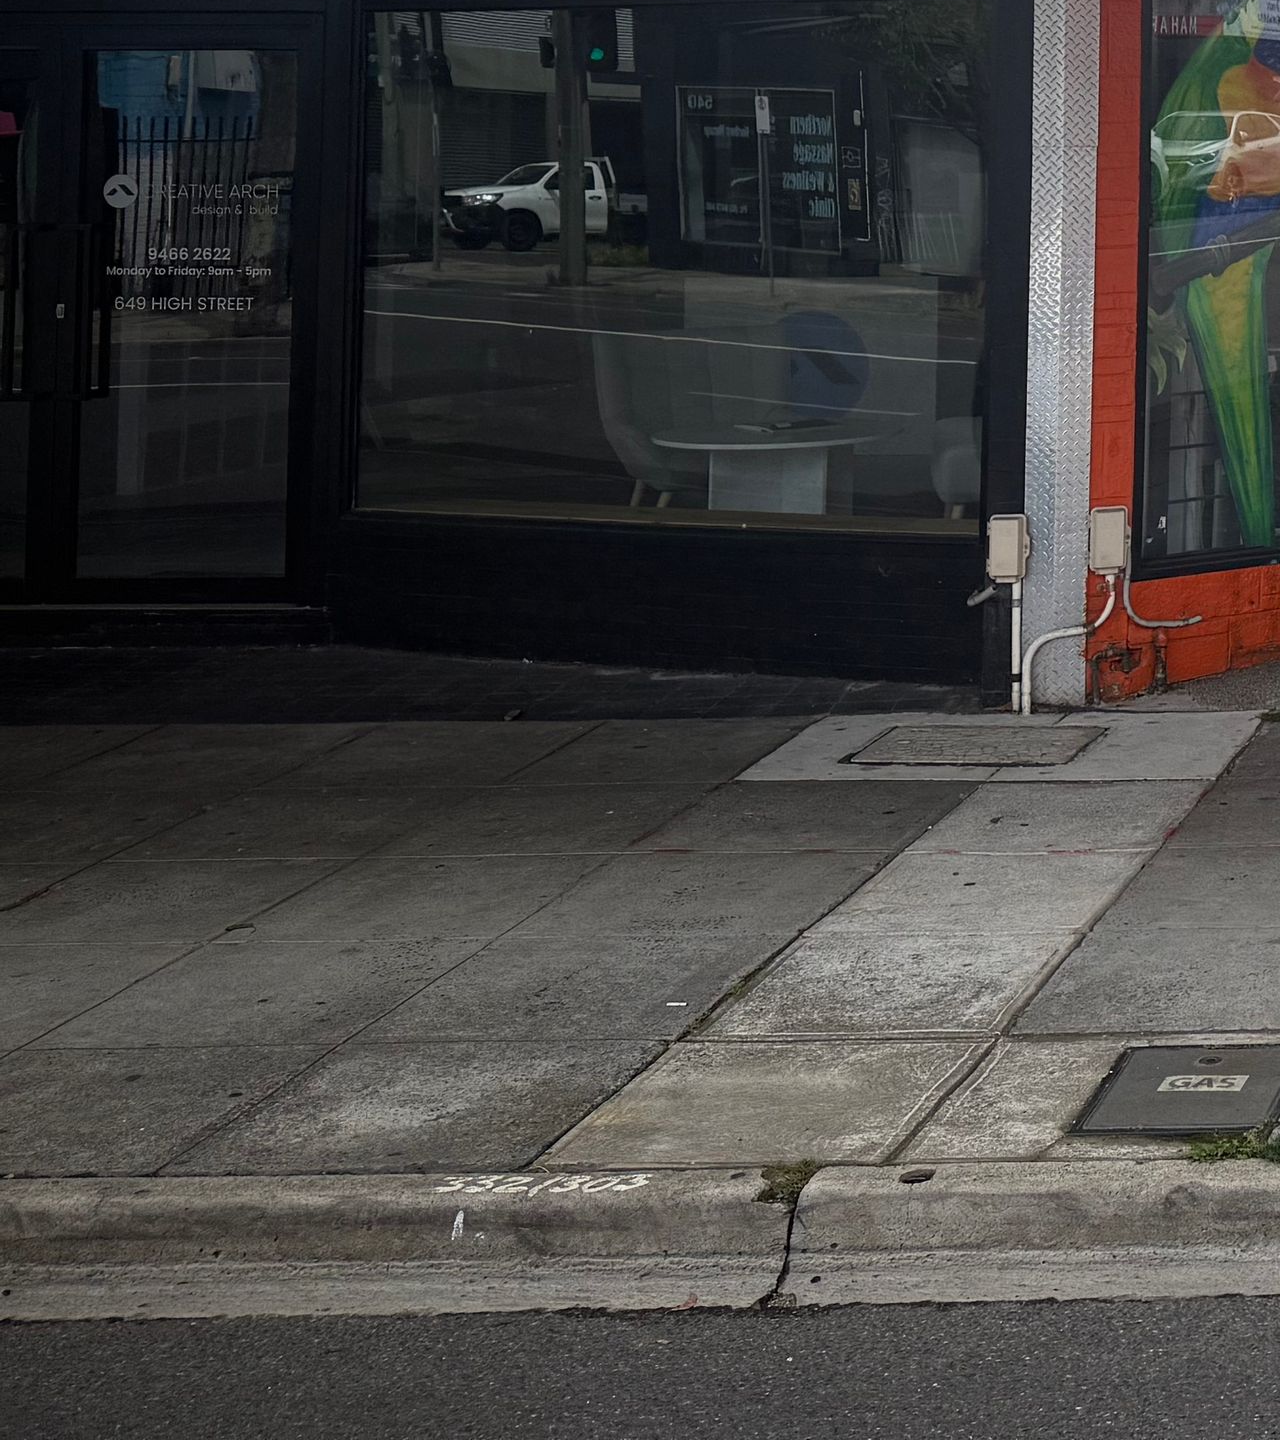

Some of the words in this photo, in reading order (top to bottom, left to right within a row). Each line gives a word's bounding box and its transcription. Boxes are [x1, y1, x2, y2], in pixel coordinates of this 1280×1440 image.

[228, 184, 279, 199] ARCH
[191, 204, 231, 217] design
[234, 205, 243, 215] &
[249, 204, 279, 215] build
[148, 247, 189, 261] 9466
[193, 247, 232, 261] 2622
[106, 266, 153, 278] Monday
[154, 266, 166, 276] to
[168, 266, 206, 278] Friday:
[207, 266, 234, 276] 9am
[245, 266, 272, 278] 5pm
[114, 296, 146, 311] 649
[151, 297, 192, 311] HIGH
[197, 296, 255, 311] STREET
[1168, 1077, 1237, 1089] GAS
